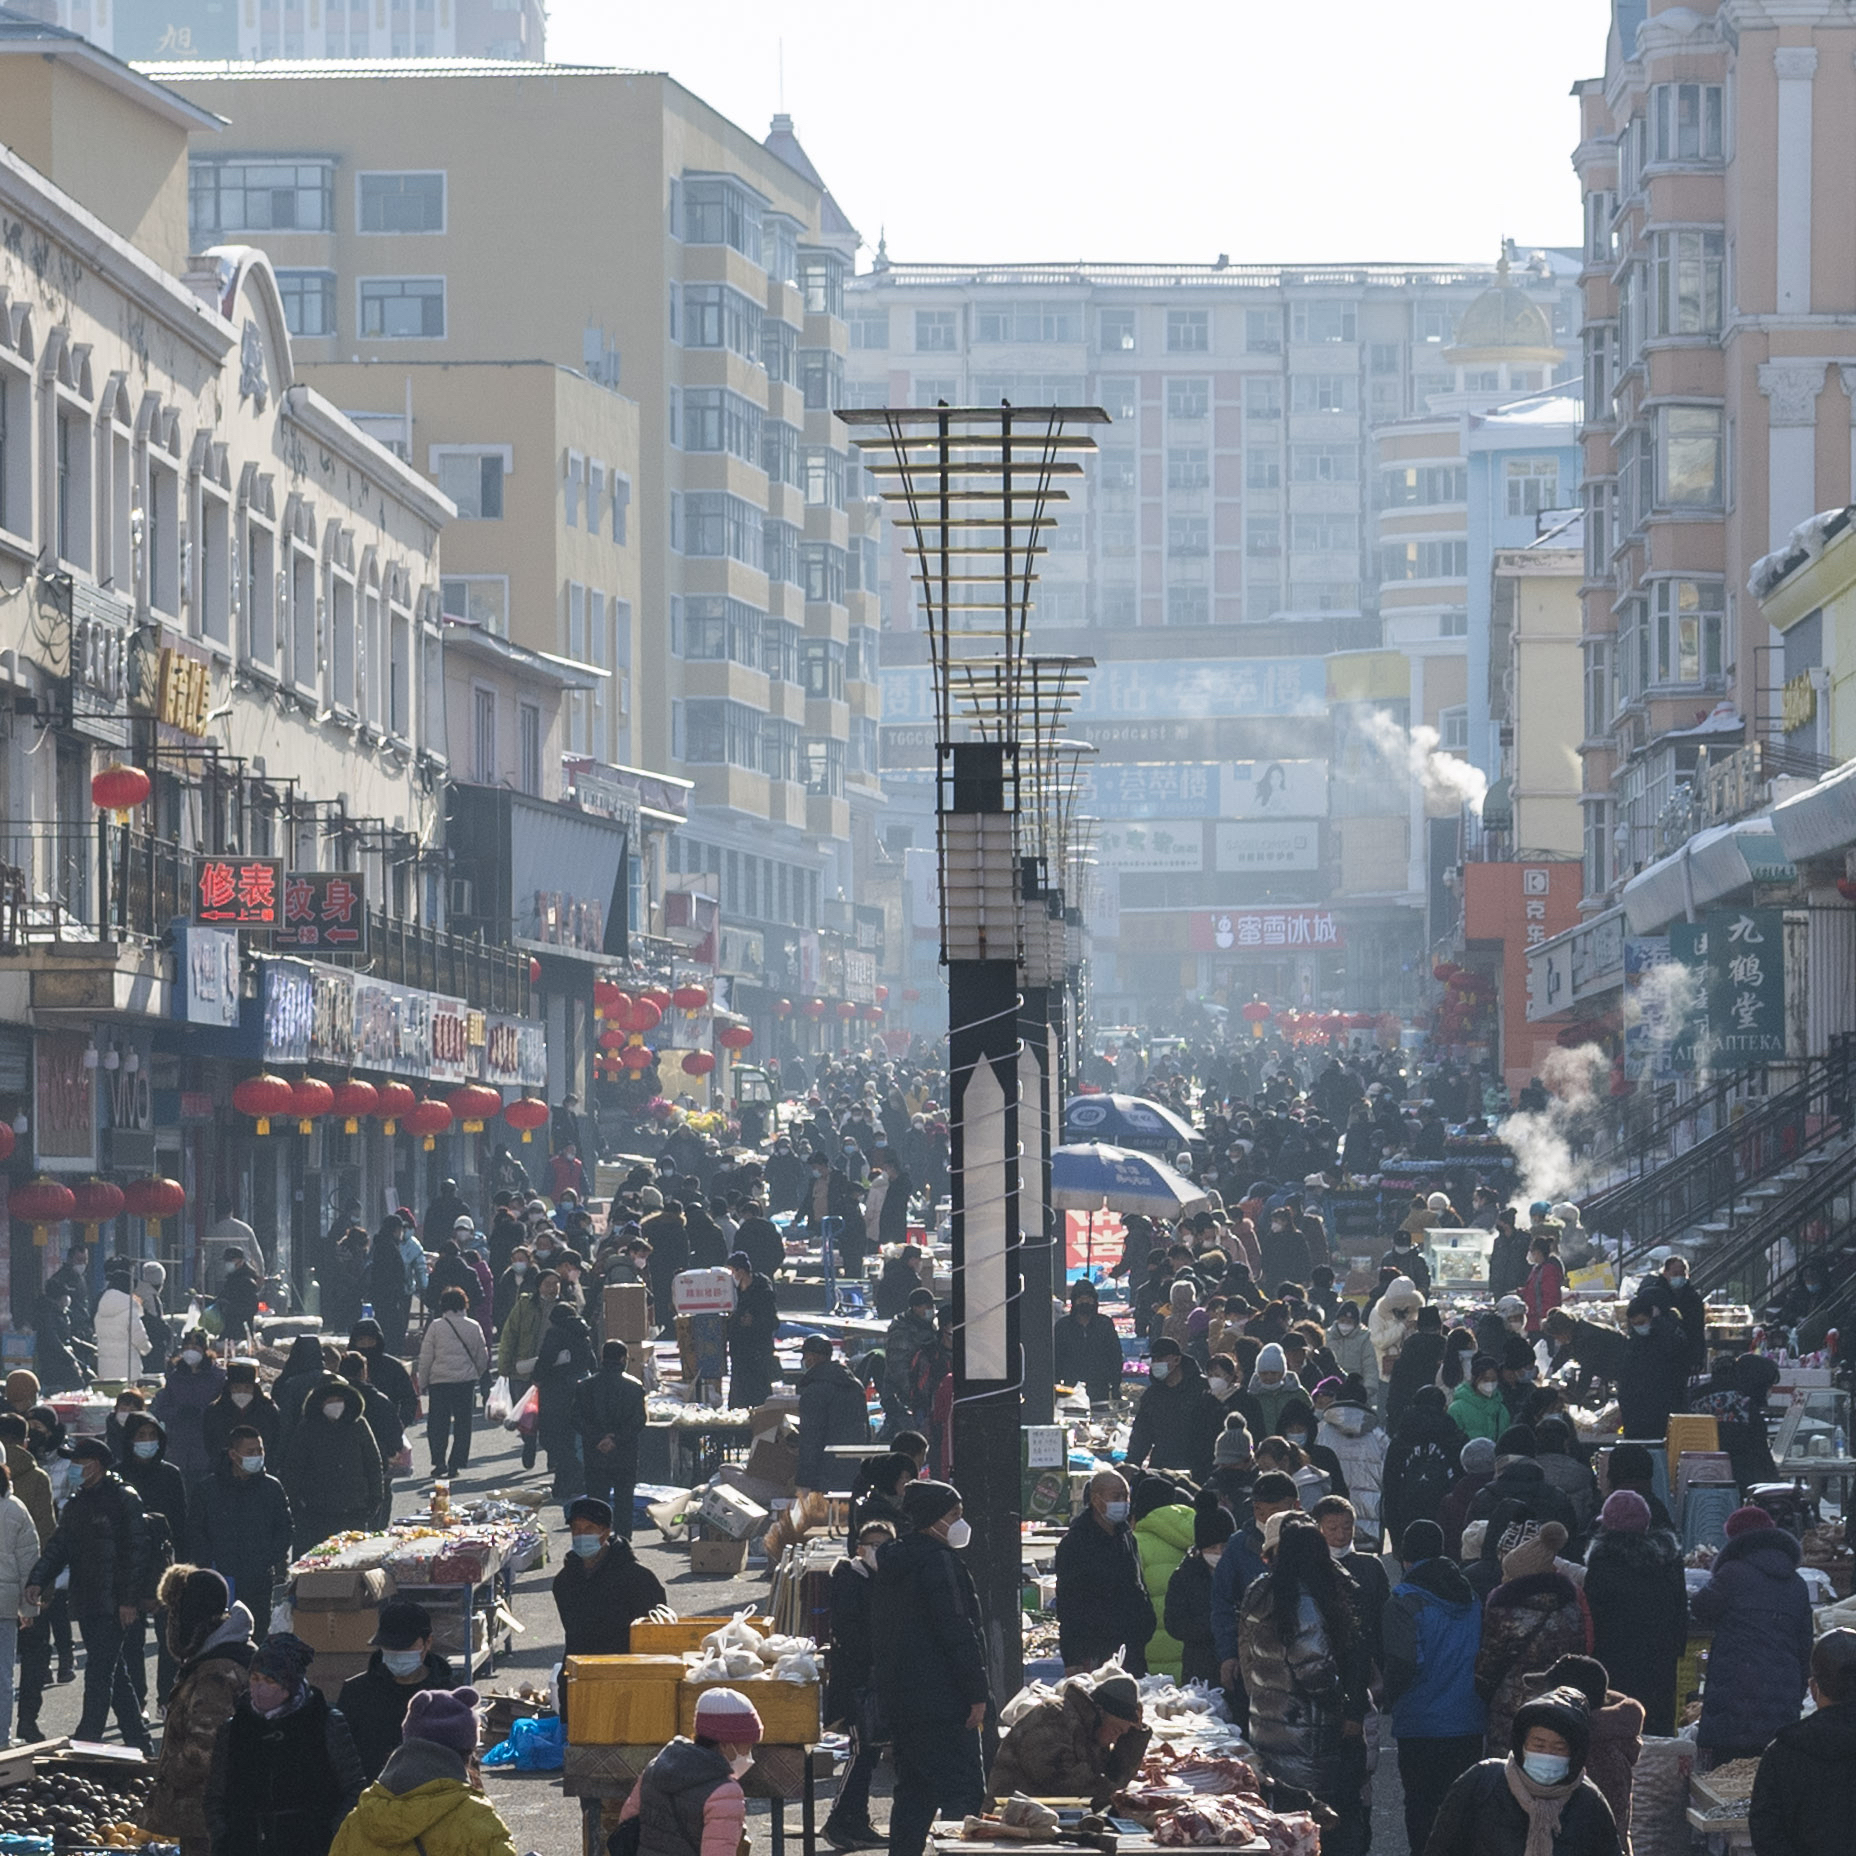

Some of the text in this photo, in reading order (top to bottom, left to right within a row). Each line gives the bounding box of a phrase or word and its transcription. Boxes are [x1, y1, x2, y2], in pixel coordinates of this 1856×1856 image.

[200, 864, 275, 907] 修表
[284, 880, 357, 921] 纹身
[1238, 914, 1337, 945] 蜜雪冰城
[1728, 914, 1765, 1029] 九鹤堂
[1713, 1034, 1784, 1050] АПТЕКА
